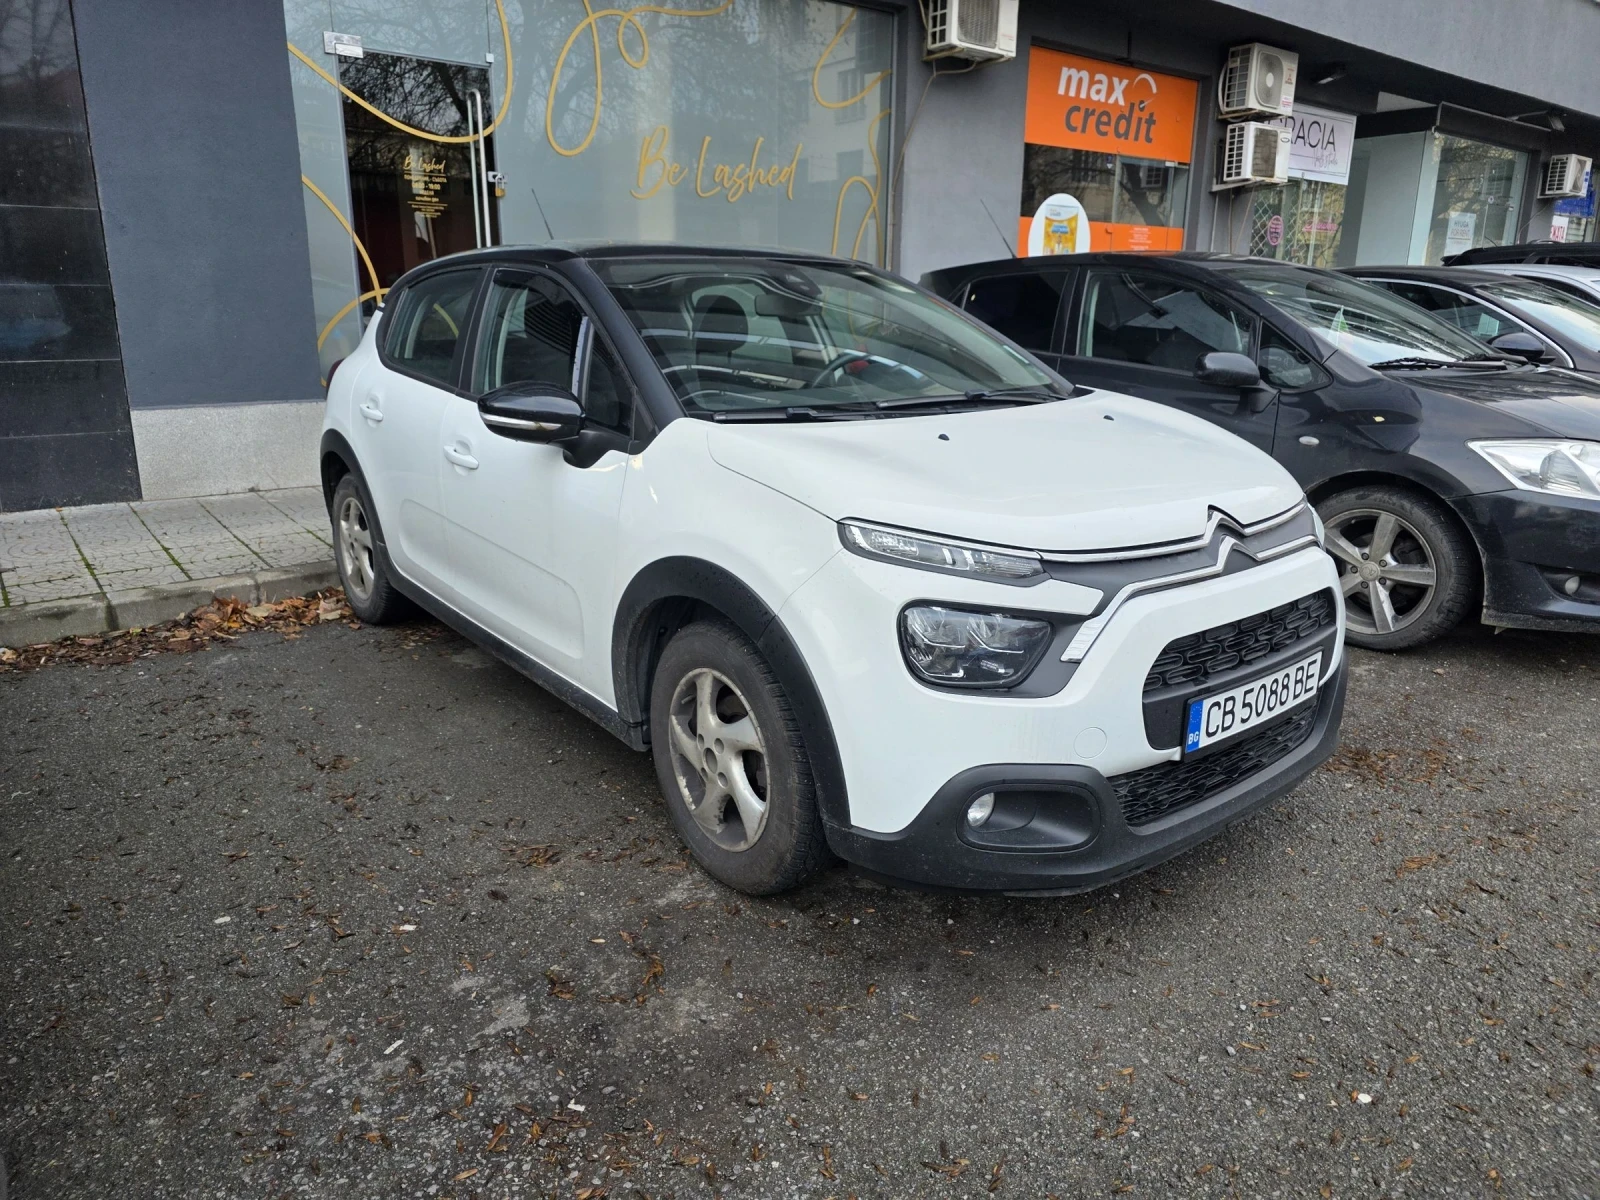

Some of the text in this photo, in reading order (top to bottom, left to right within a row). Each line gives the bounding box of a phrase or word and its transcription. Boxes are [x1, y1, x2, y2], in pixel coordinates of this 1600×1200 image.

[1057, 66, 1129, 106] max
[1065, 100, 1156, 143] credit
[1268, 116, 1336, 152] RACIA
[418, 157, 446, 173] Lashed
[629, 125, 803, 203] Be Lashed
[1205, 659, 1318, 738] CB 5088 BE
[1187, 731, 1199, 745] BG
